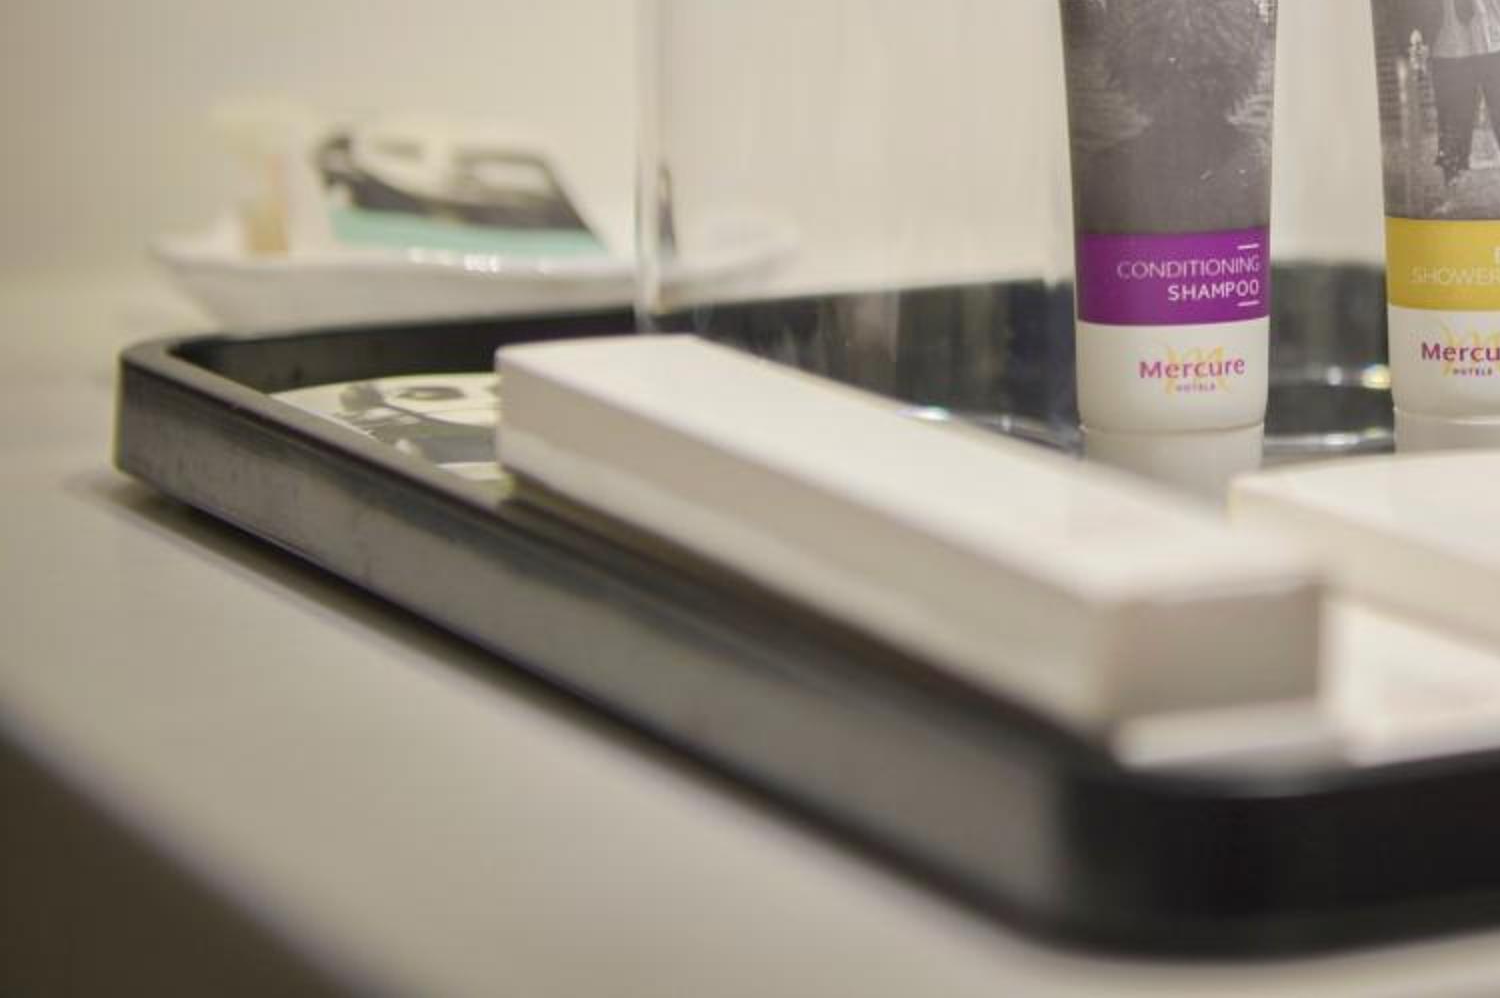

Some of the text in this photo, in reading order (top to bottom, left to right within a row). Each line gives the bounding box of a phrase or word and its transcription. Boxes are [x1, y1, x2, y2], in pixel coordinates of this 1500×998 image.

[1116, 254, 1260, 280] CONDITIONING
[1167, 278, 1260, 301] SHAMPOO
[1138, 357, 1246, 379] Mercure
